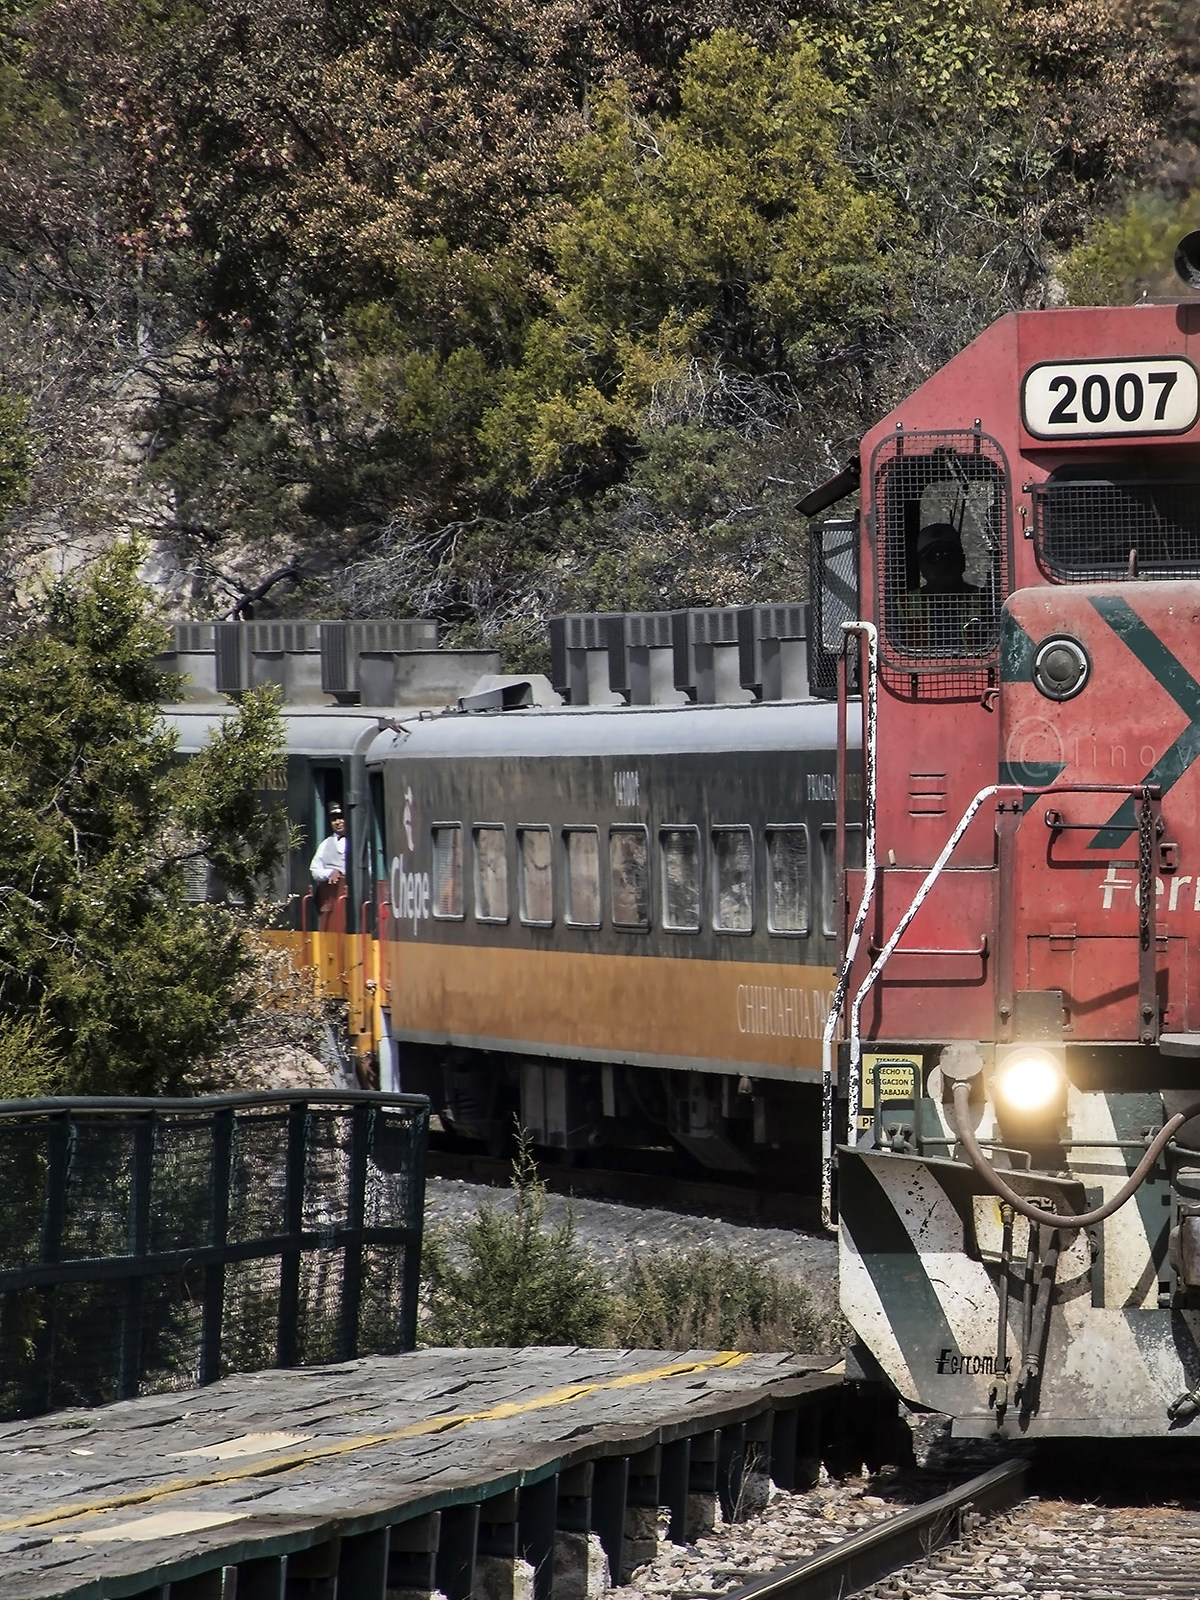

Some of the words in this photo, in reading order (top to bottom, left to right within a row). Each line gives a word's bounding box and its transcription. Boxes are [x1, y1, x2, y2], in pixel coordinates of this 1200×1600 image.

[1047, 371, 1178, 424] 2007
[391, 853, 429, 936] Chepe
[737, 984, 812, 1038] CHIHUAHUA
[879, 1088, 911, 1096] RABAJAR
